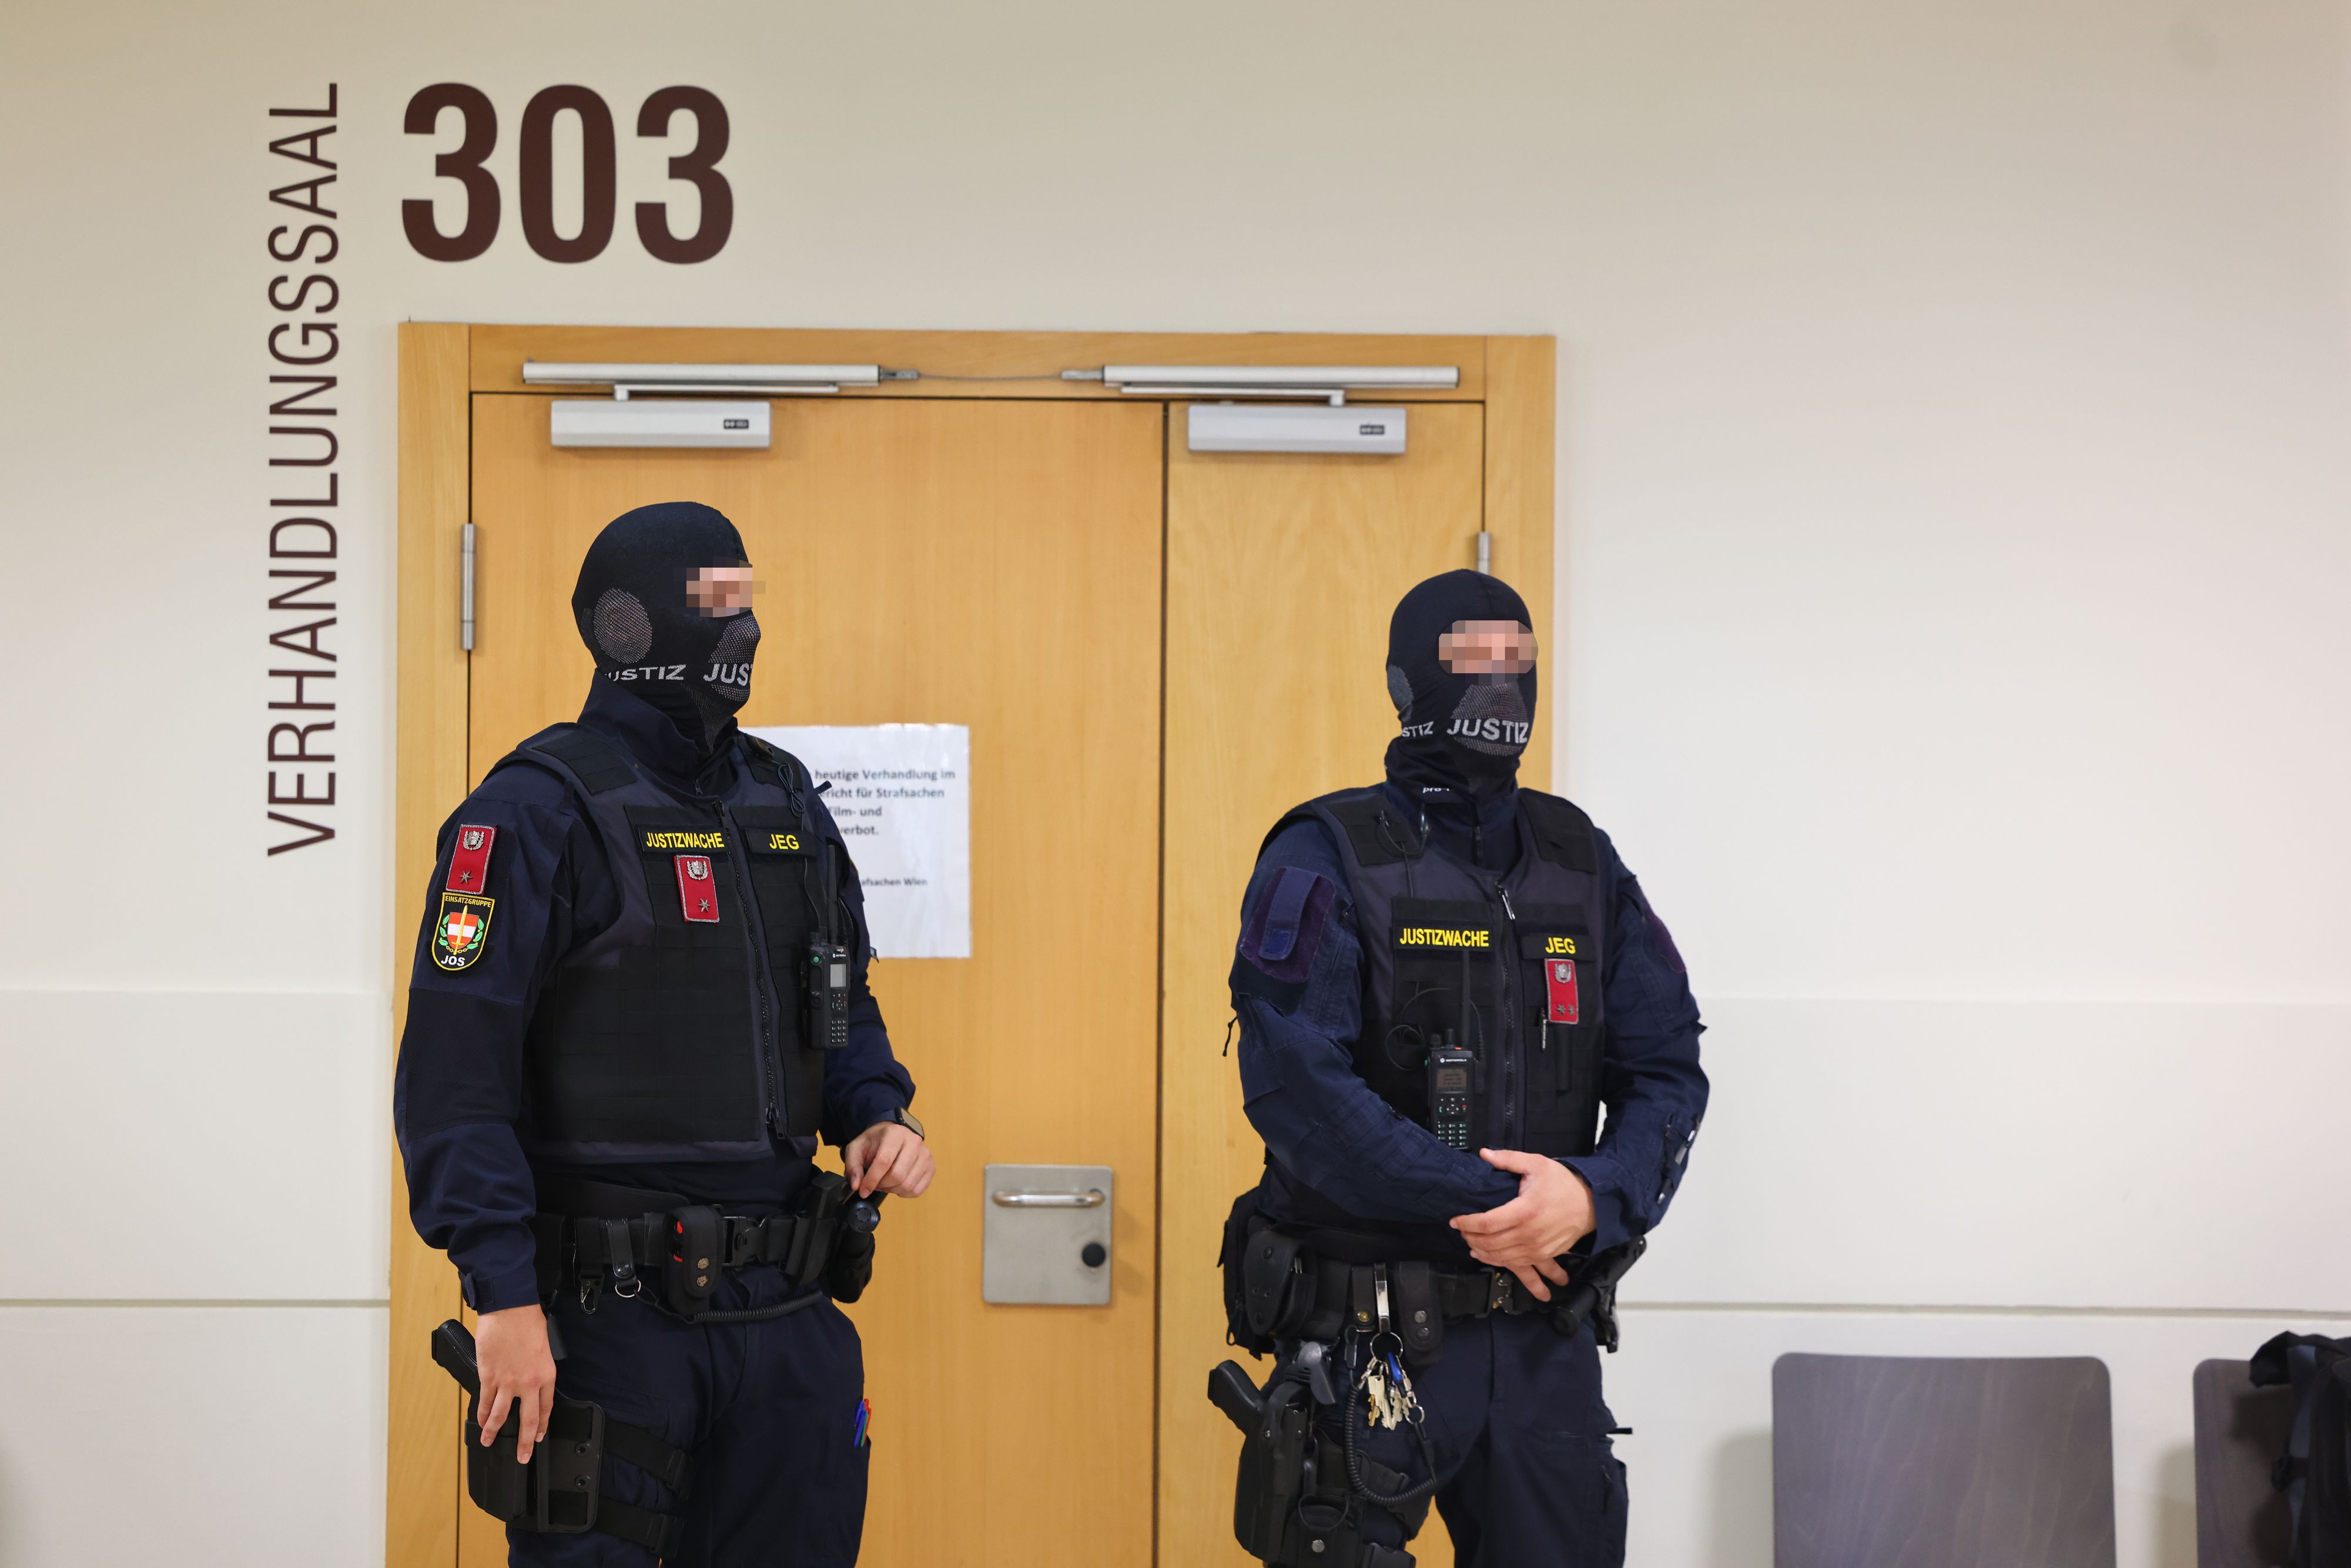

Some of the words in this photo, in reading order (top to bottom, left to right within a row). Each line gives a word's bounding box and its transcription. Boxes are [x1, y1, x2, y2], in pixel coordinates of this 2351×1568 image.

[401, 82, 734, 264] 303
[267, 83, 339, 857] VERHANDLUNGSSAAL
[605, 664, 686, 682] USTIZ
[703, 662, 753, 686] JUS
[1446, 718, 1529, 744] JUSTIZ
[815, 769, 859, 781] heutige
[863, 769, 937, 782] Verhandlung
[941, 769, 956, 779] im
[857, 788, 872, 798] für
[876, 788, 945, 798] Strafsachen
[860, 806, 882, 816] und
[646, 832, 725, 849] JUSTIZWACHE
[769, 833, 800, 850] JEG
[445, 895, 492, 907] EINSATZGRUPPE
[1399, 928, 1489, 947] JUSTIZWACHE
[1545, 937, 1576, 954] JEG
[441, 954, 465, 967] JOS
